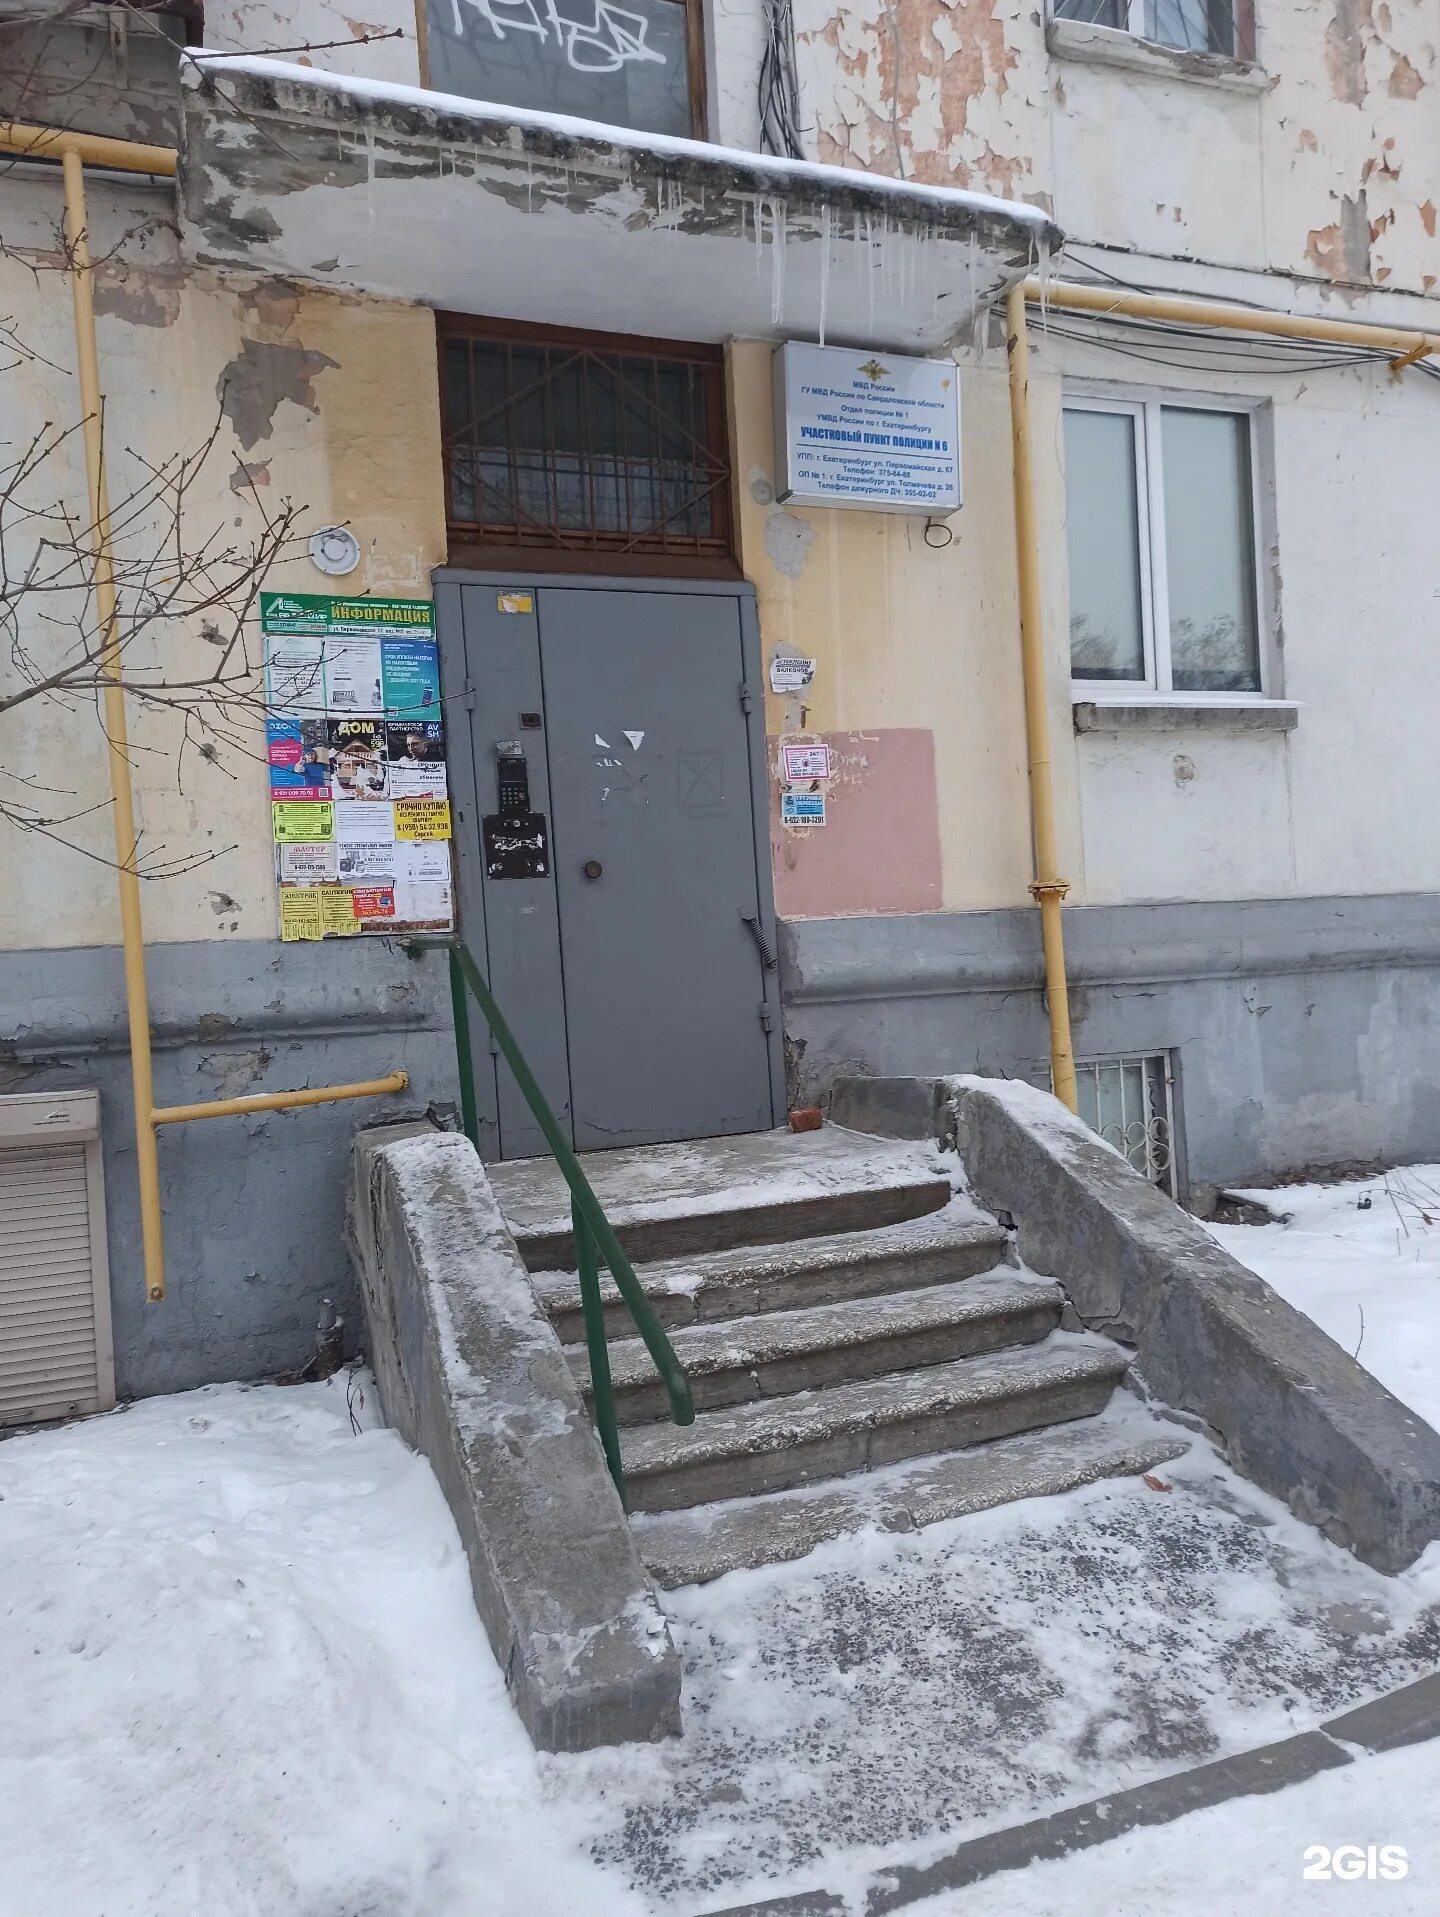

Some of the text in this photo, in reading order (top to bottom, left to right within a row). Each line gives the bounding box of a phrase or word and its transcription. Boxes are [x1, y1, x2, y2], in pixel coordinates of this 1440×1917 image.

[853, 381, 895, 392] МВД России
[811, 388, 828, 396] МВД
[830, 390, 855, 398] России
[867, 393, 916, 406] Свердловской
[917, 399, 945, 409] области
[841, 405, 863, 413] Отдел
[865, 408, 894, 417] полиции
[817, 414, 838, 423] УМВД
[840, 416, 864, 425] России
[882, 420, 932, 433] Екатеринбургу
[801, 426, 862, 443] УЧАСТКОВЫЙ
[864, 433, 890, 446] ПУНКТ
[892, 436, 933, 450] ПОЛИЦИИ
[942, 441, 948, 452] 6
[797, 452, 814, 460] УПП:
[823, 455, 872, 467] Екатеринбург
[873, 460, 884, 468] ул.
[886, 461, 936, 472] Первомайская
[945, 466, 954, 474] 67
[843, 466, 875, 475] Телефон:
[798, 470, 810, 478] ОП
[837, 474, 884, 486] Екатеринбург
[887, 479, 898, 487] ул.
[900, 480, 936, 490] Толмачева
[818, 481, 937, 499] Телефон дежурного ДЧ: 355-02-02
[331, 605, 430, 623] ИНФОРМАЦИЯ
[338, 722, 375, 735] ДОМ
[427, 723, 440, 731] AV
[427, 730, 440, 738] SH
[396, 801, 447, 811] СРОЧНО КУПЛЮ
